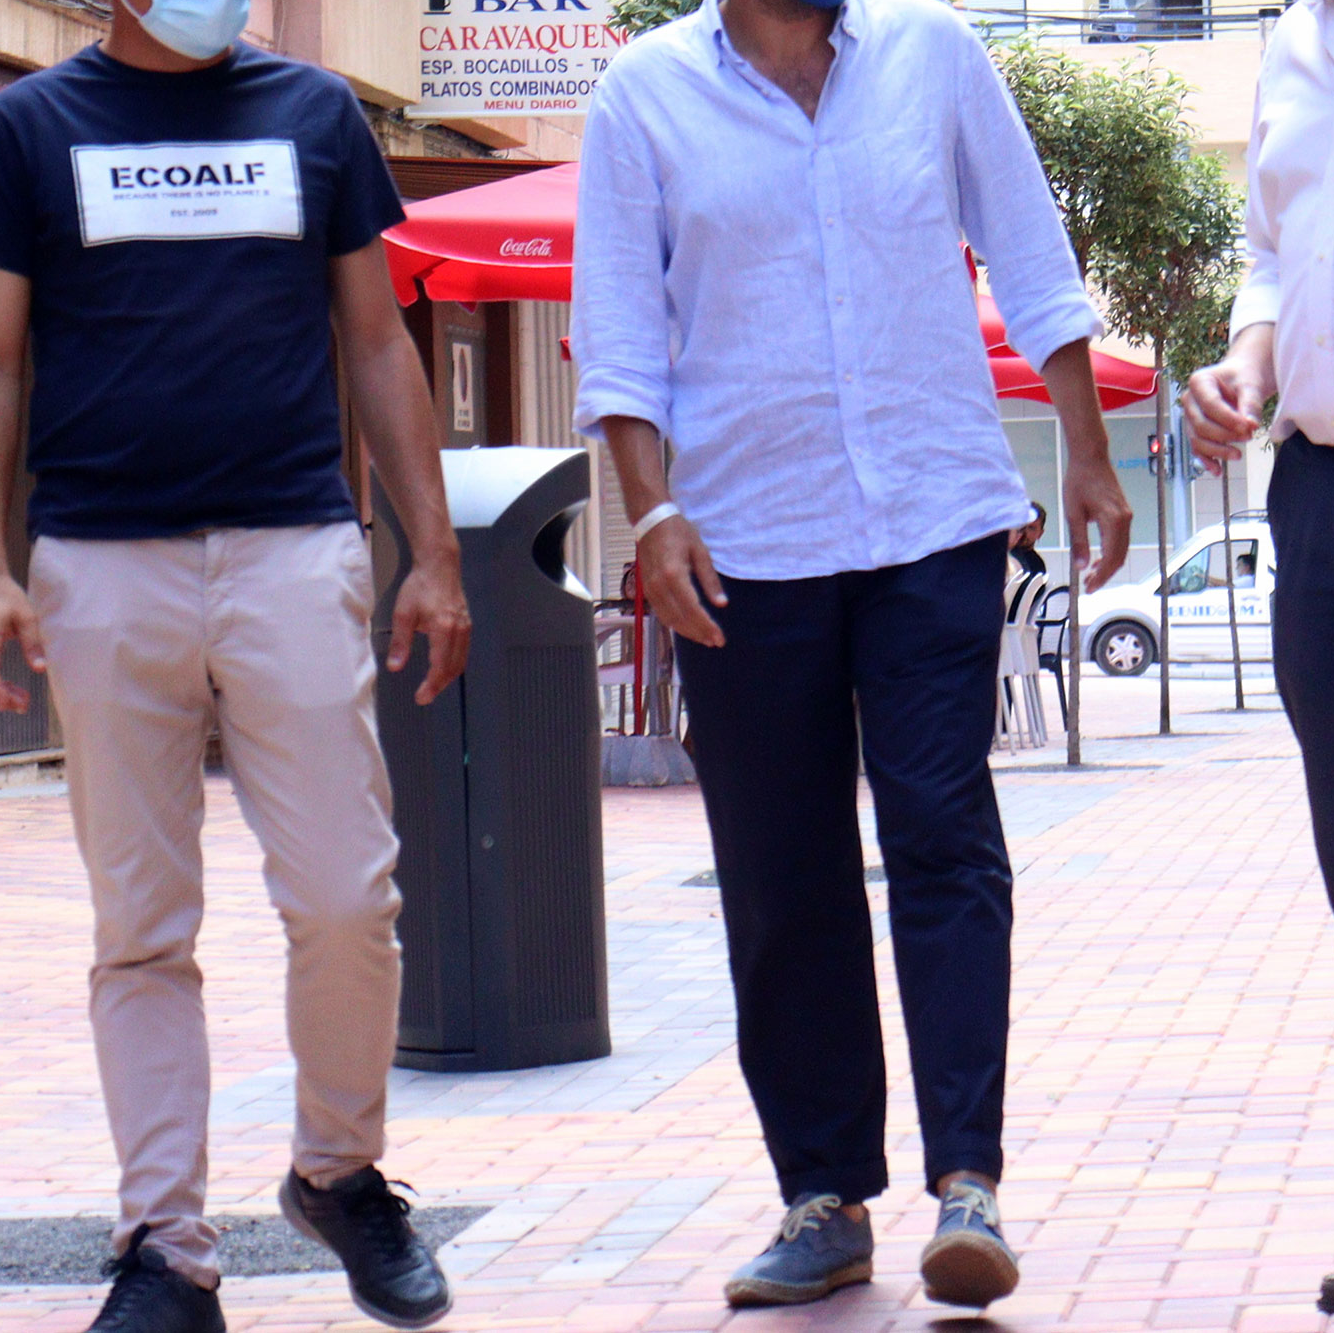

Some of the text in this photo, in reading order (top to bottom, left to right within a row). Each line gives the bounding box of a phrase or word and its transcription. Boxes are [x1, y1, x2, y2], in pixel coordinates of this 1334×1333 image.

[420, 59, 456, 75] ESP.
[464, 58, 568, 74] BOCADILLOS
[420, 81, 482, 97] PLATOS
[484, 99, 577, 110] MENU DIARIO
[111, 162, 265, 189] ECOALF
[113, 192, 158, 200] BECAUSE
[499, 237, 554, 257] Coca-Cola
